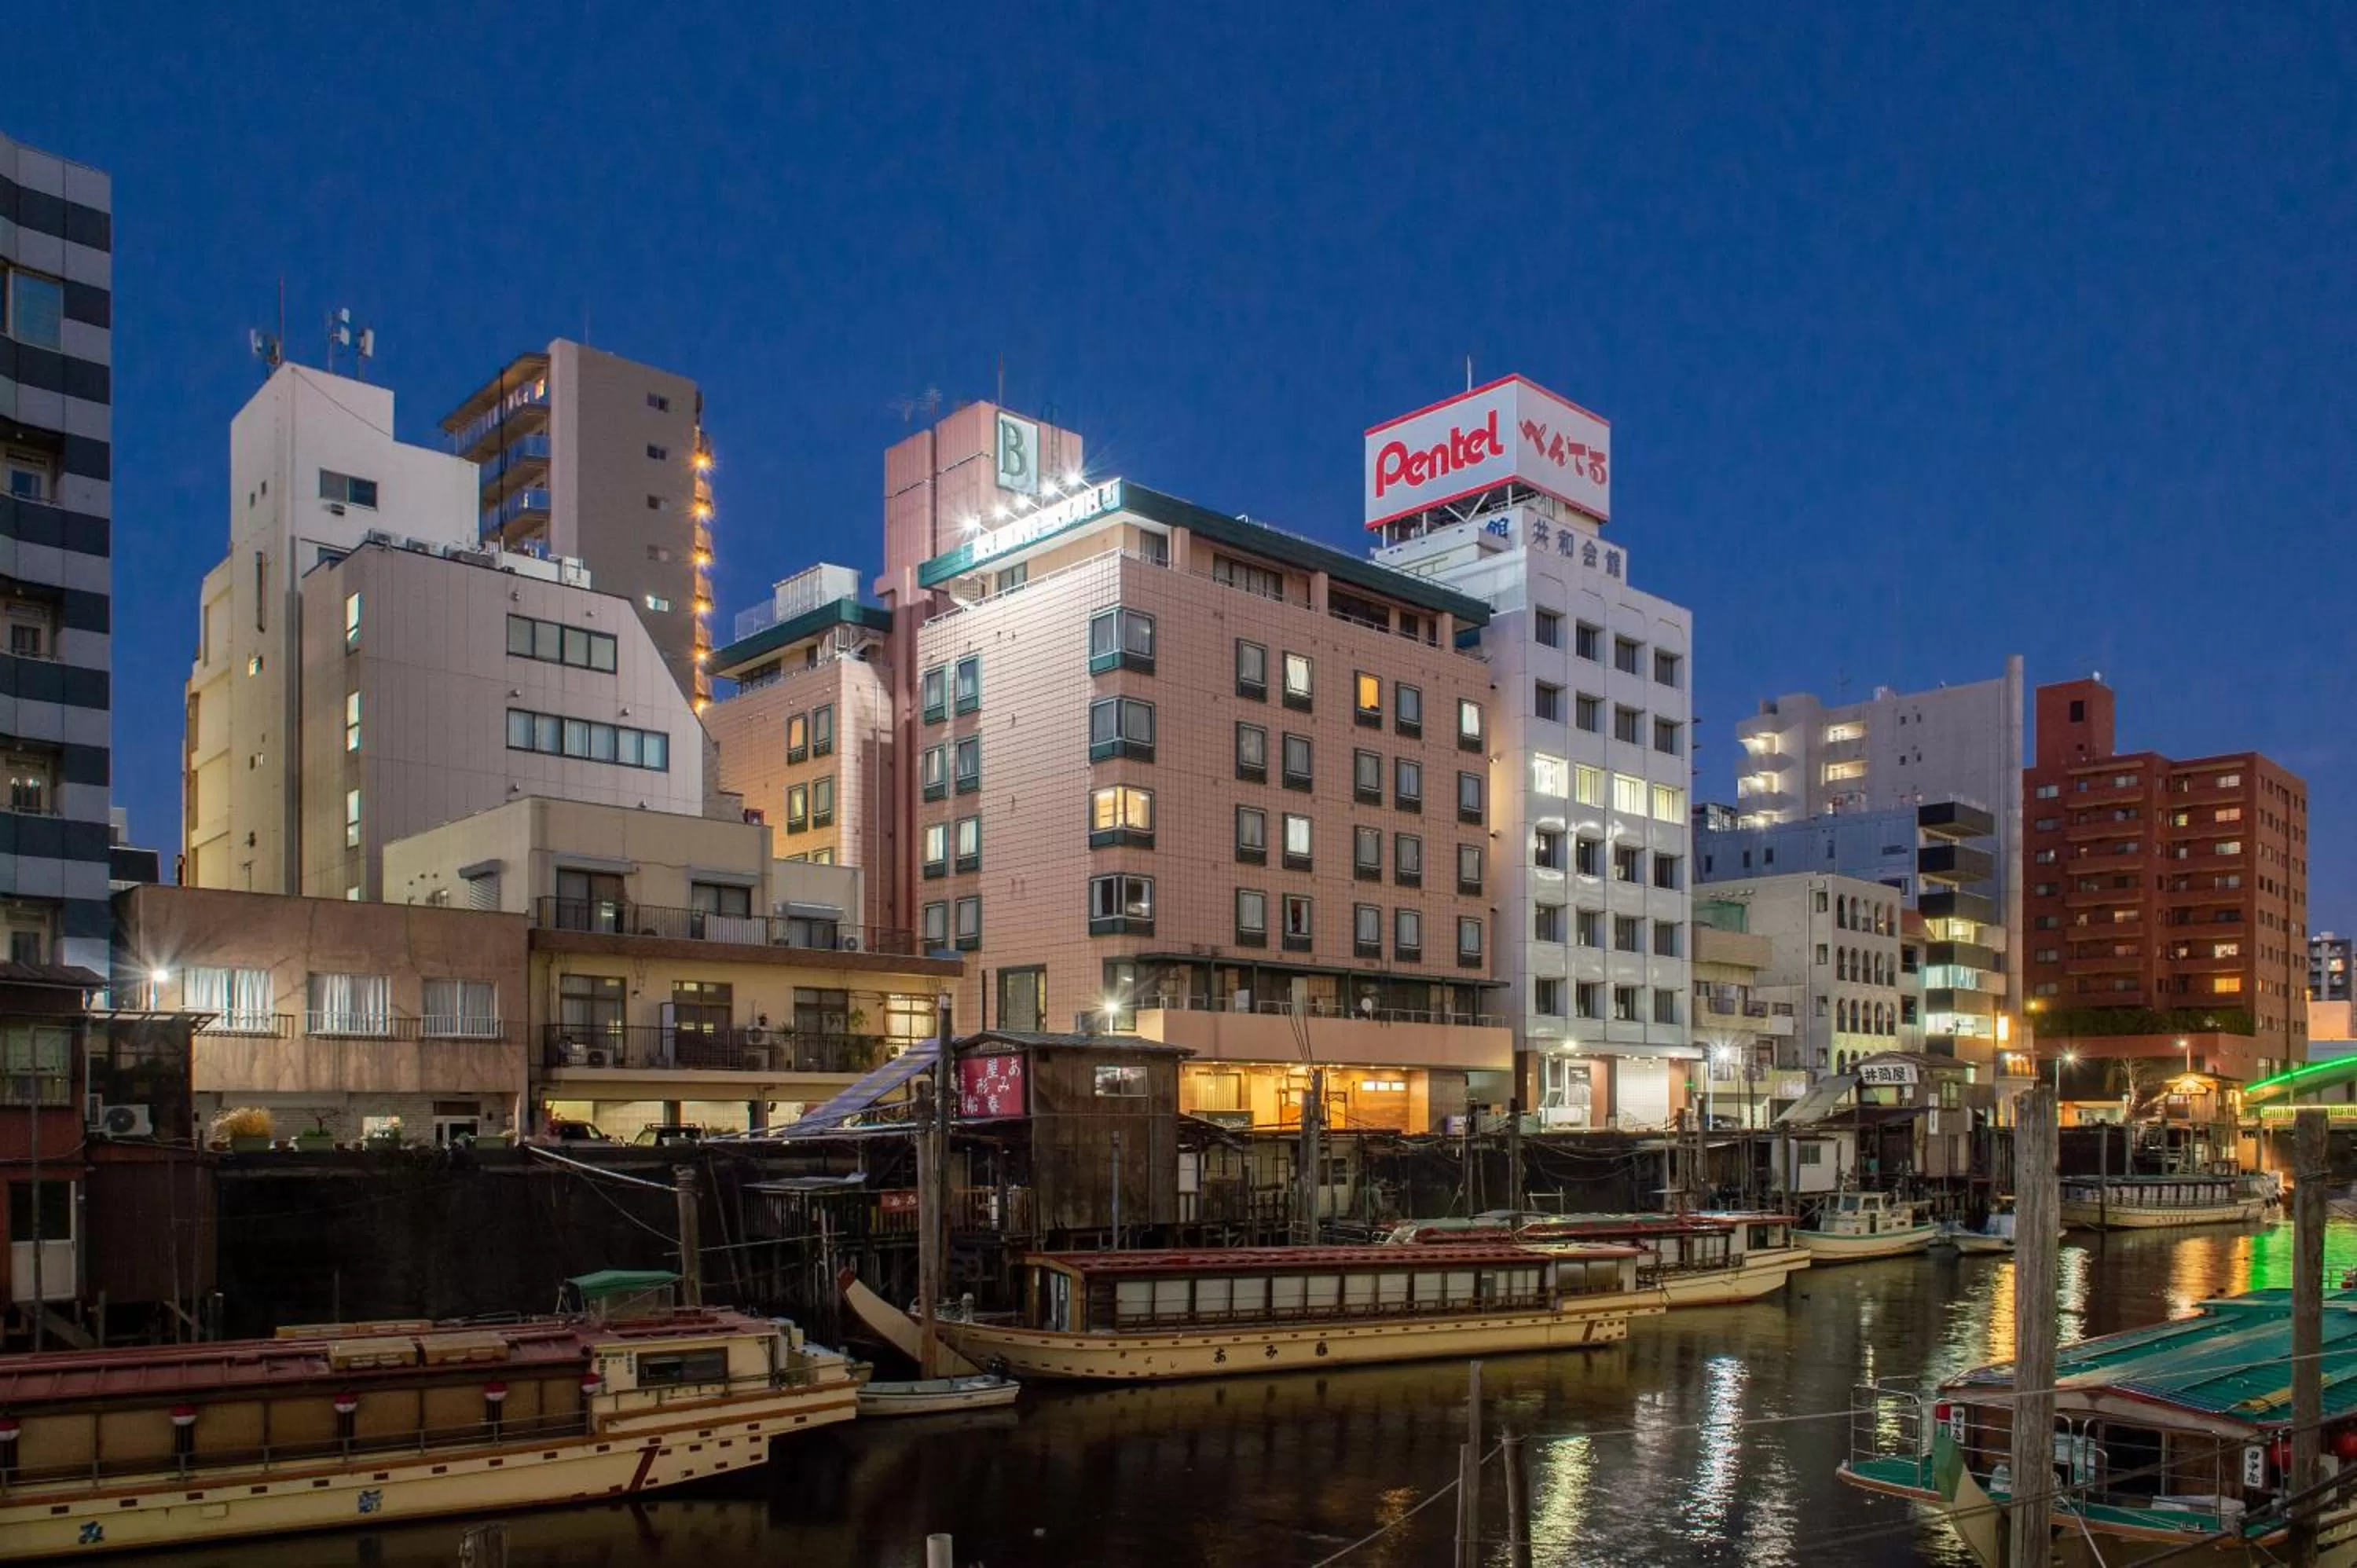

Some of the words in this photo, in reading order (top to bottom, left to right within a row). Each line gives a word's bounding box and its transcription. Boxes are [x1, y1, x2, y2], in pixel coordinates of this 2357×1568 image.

[1001, 419, 1027, 476] B
[1376, 409, 1504, 498] Pentel
[1519, 418, 1607, 485] ぺんてる
[1532, 518, 1621, 578] 共和会館
[1864, 1066, 1907, 1082] 井筒屋
